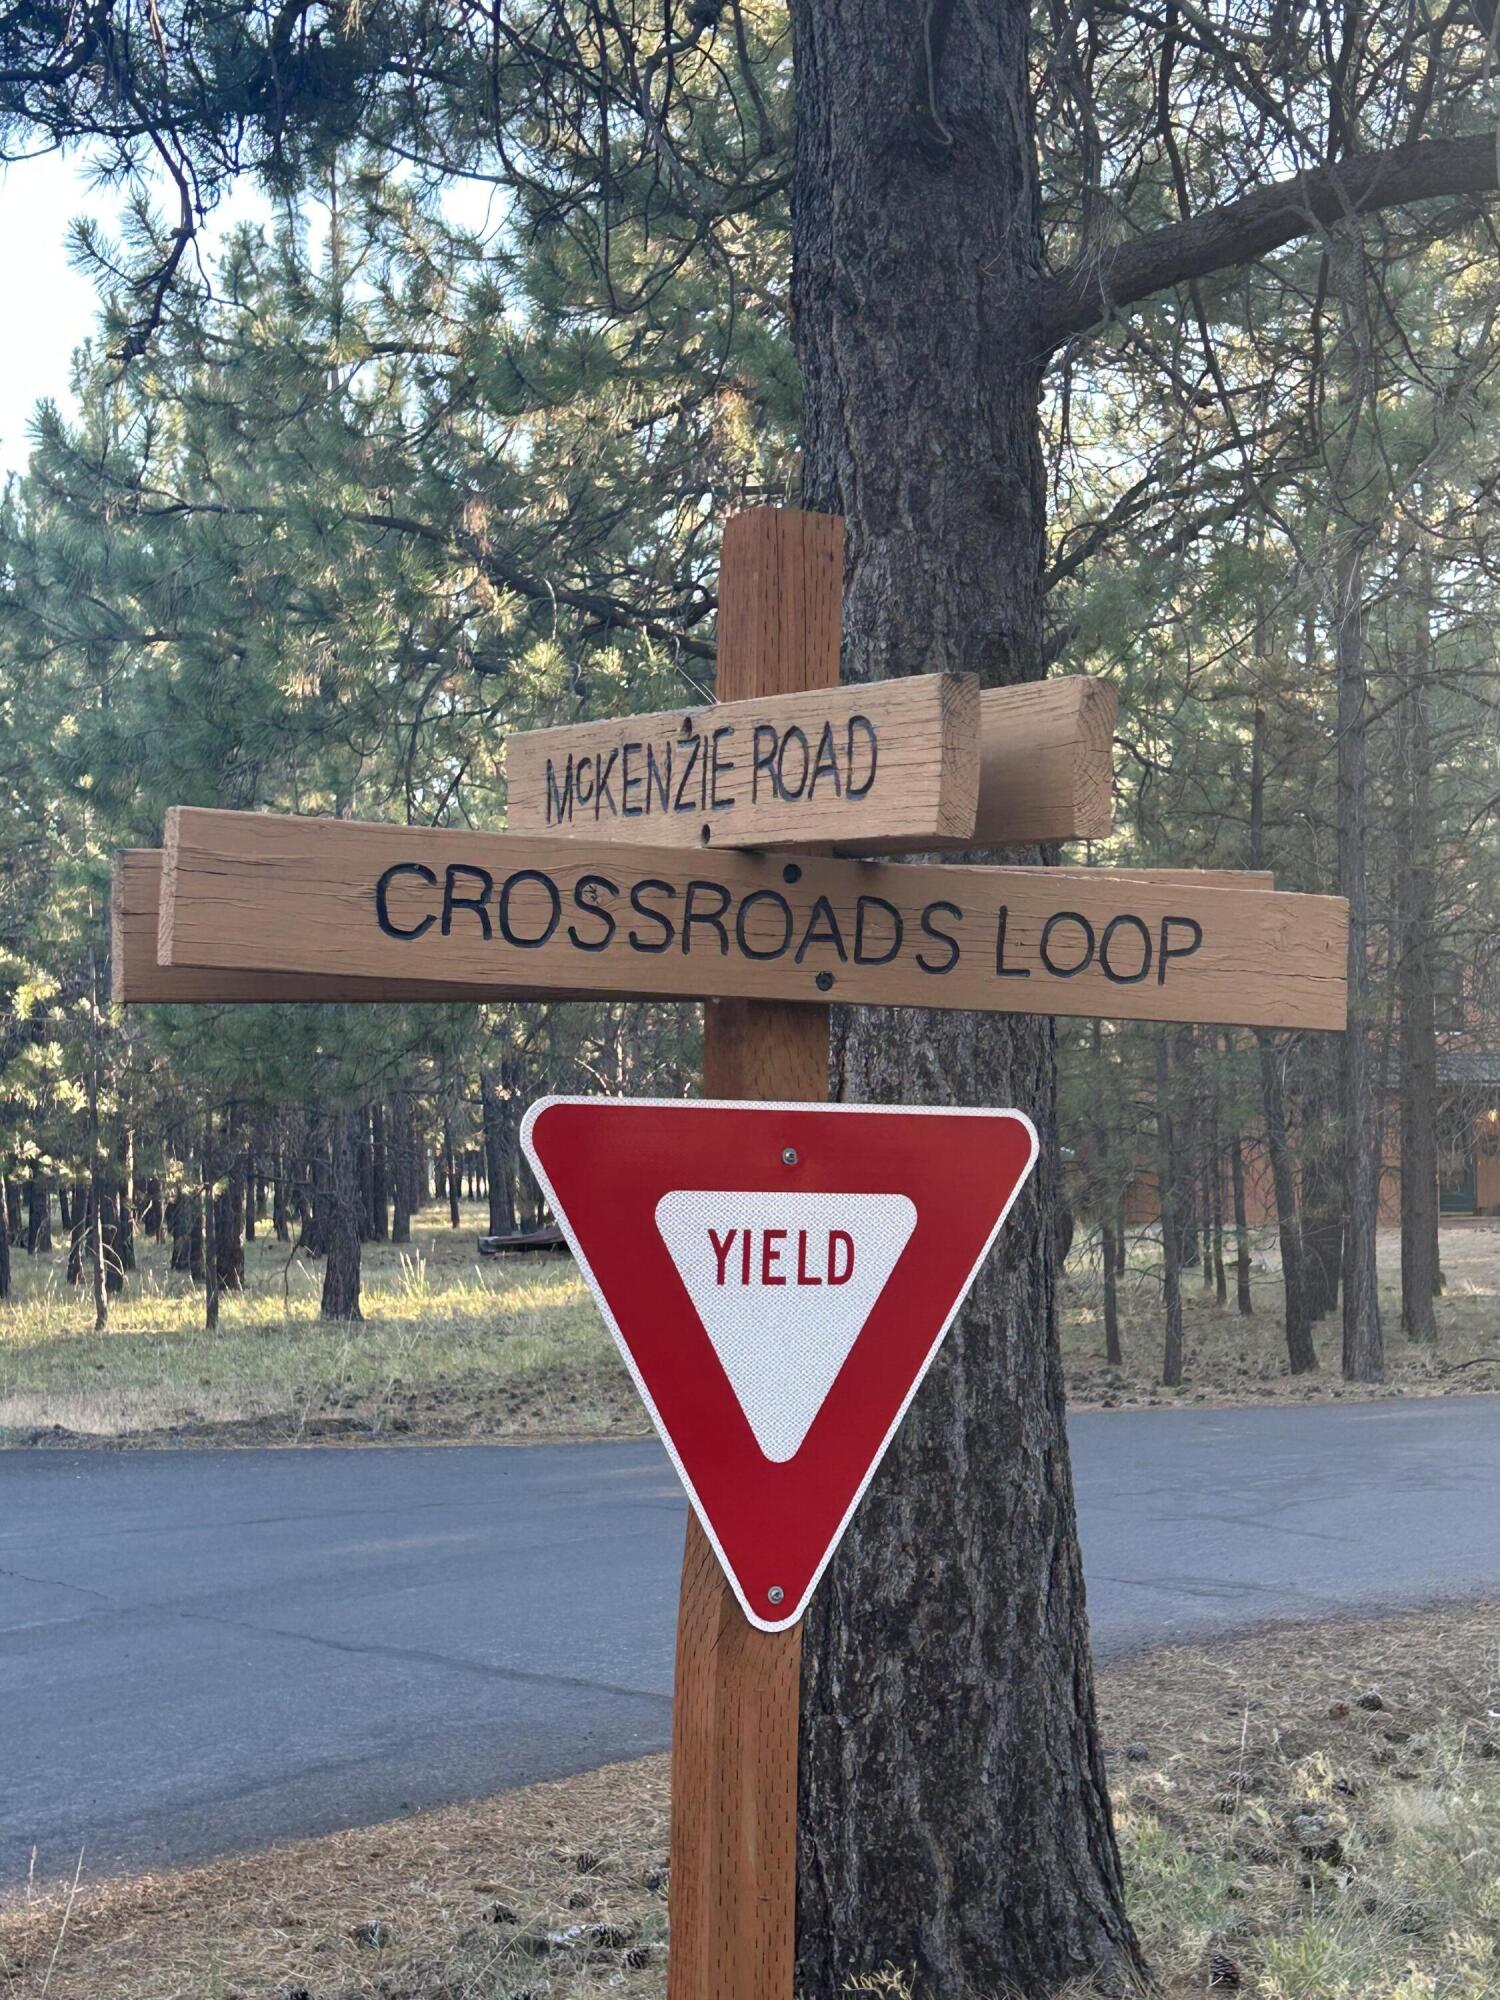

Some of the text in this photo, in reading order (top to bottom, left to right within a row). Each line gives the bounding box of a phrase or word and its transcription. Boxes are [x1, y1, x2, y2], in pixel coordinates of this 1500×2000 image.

[753, 715, 878, 804] ROAD
[376, 863, 1202, 986] CROSSROADS LOOP
[707, 1229, 855, 1286] YIELD
